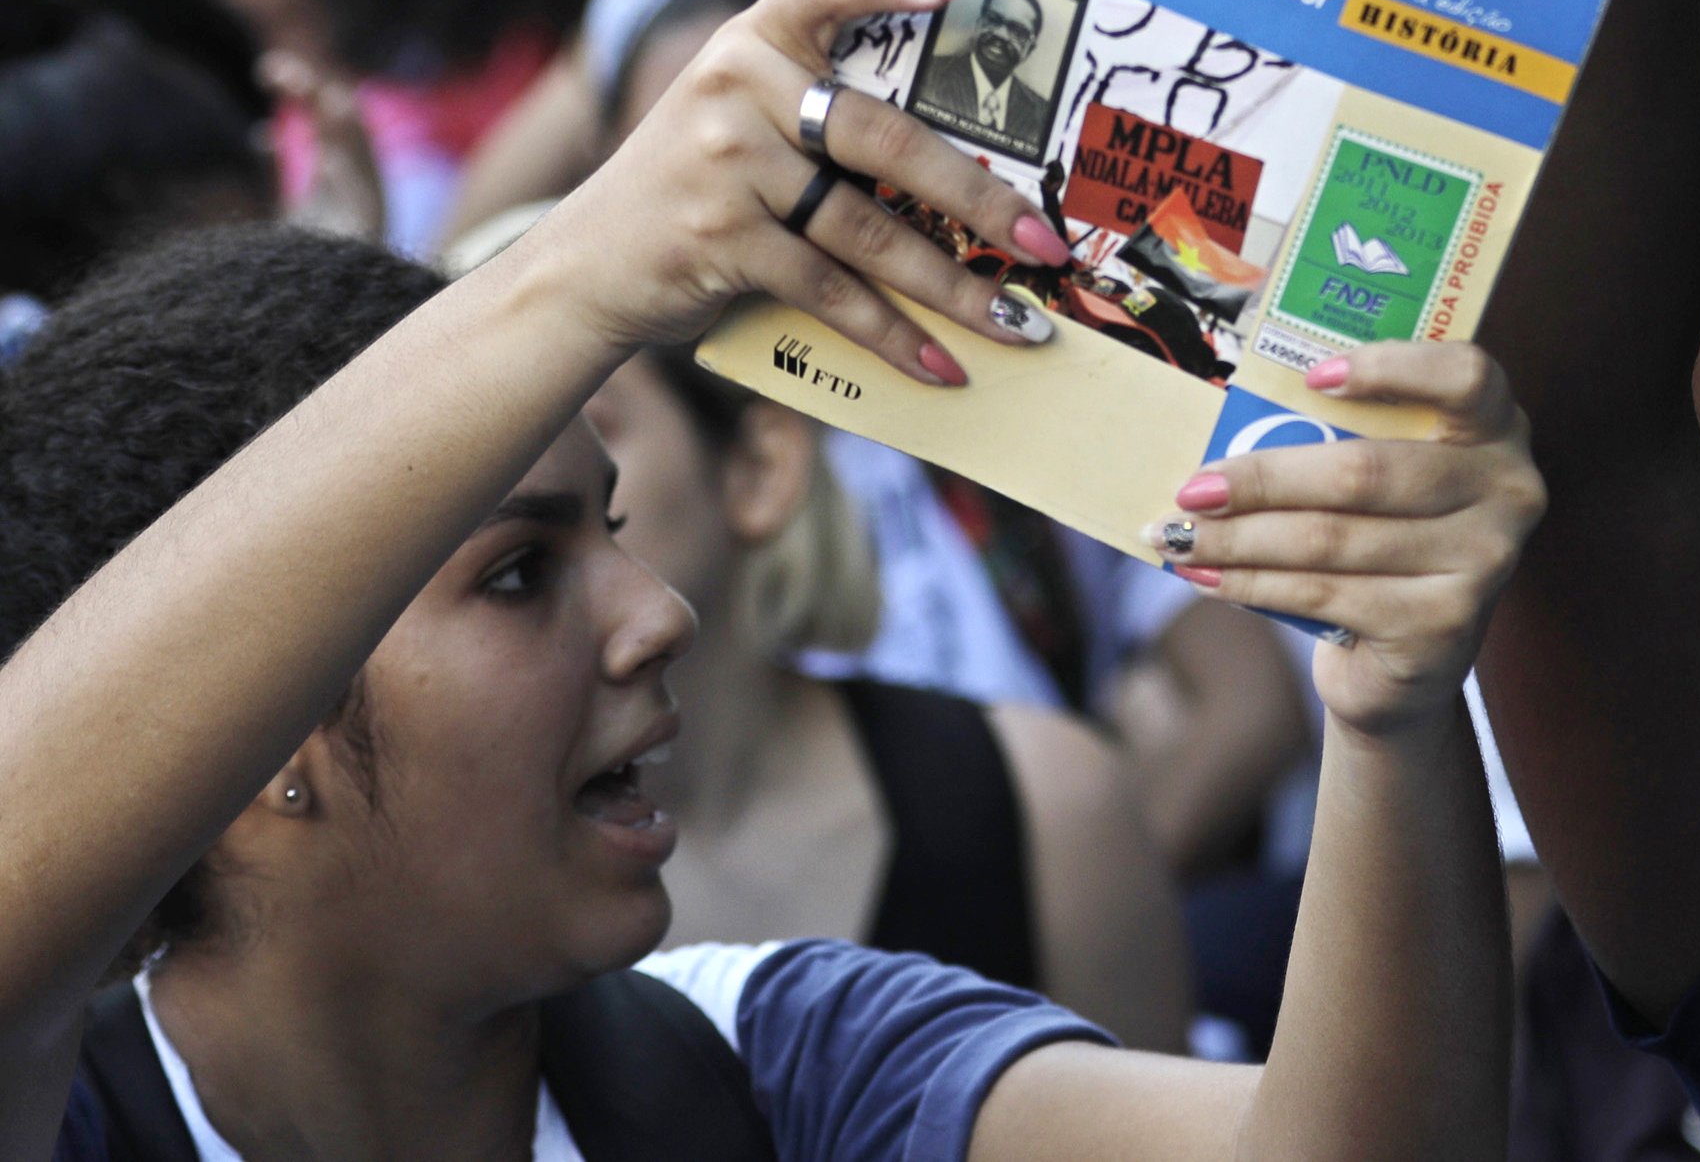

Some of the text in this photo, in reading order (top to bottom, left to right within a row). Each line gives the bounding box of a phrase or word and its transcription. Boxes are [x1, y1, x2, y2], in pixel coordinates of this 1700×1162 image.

[1358, 2, 1519, 77] HISTÓRIA
[1107, 115, 1233, 189] MPLA
[1333, 166, 1389, 195] 2011
[1359, 153, 1447, 196] PNLD
[1360, 193, 1417, 224] 2012
[1447, 181, 1504, 291] PROIBIDA
[1319, 276, 1391, 318] FNDE
[812, 368, 863, 401] FTD
